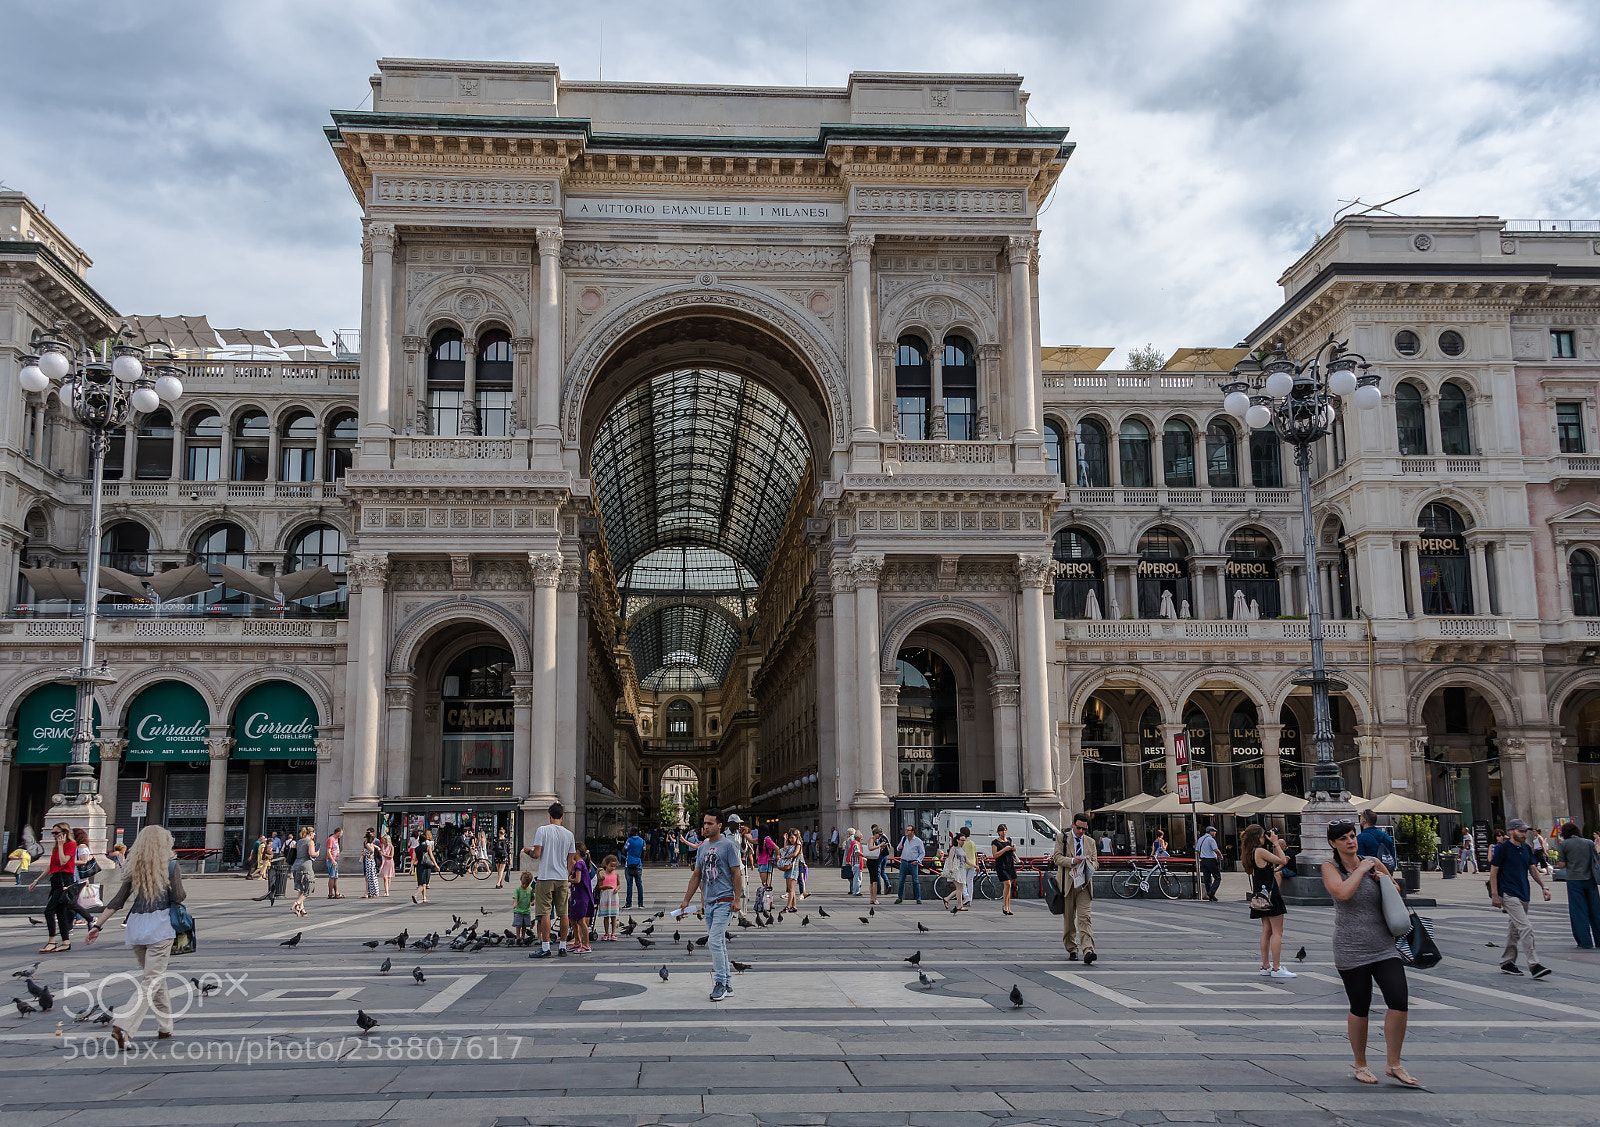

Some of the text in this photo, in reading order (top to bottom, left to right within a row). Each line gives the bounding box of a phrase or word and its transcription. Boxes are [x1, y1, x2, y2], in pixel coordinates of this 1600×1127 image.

[580, 203, 589, 213] A
[597, 203, 655, 214] VITTORIO
[662, 205, 731, 216] EMANUELE
[771, 207, 828, 217] MILANESI
[1138, 561, 1181, 574] APEROL
[1226, 561, 1269, 574] APEROL
[113, 603, 154, 611] TERRAZZA
[156, 603, 186, 611] DUOMO
[447, 709, 514, 726] CAMPAR
[136, 714, 206, 742] Currado
[244, 712, 313, 739] Currado
[33, 727, 75, 739] GRIMO
[1143, 729, 1153, 738] IL
[1233, 729, 1243, 738] IL
[904, 748, 933, 759] Motta
[1080, 748, 1100, 758] otta
[1176, 740, 1186, 759] M
[1232, 747, 1259, 755] FOOD
[466, 768, 500, 776] CAMPARI
[142, 785, 151, 798] M
